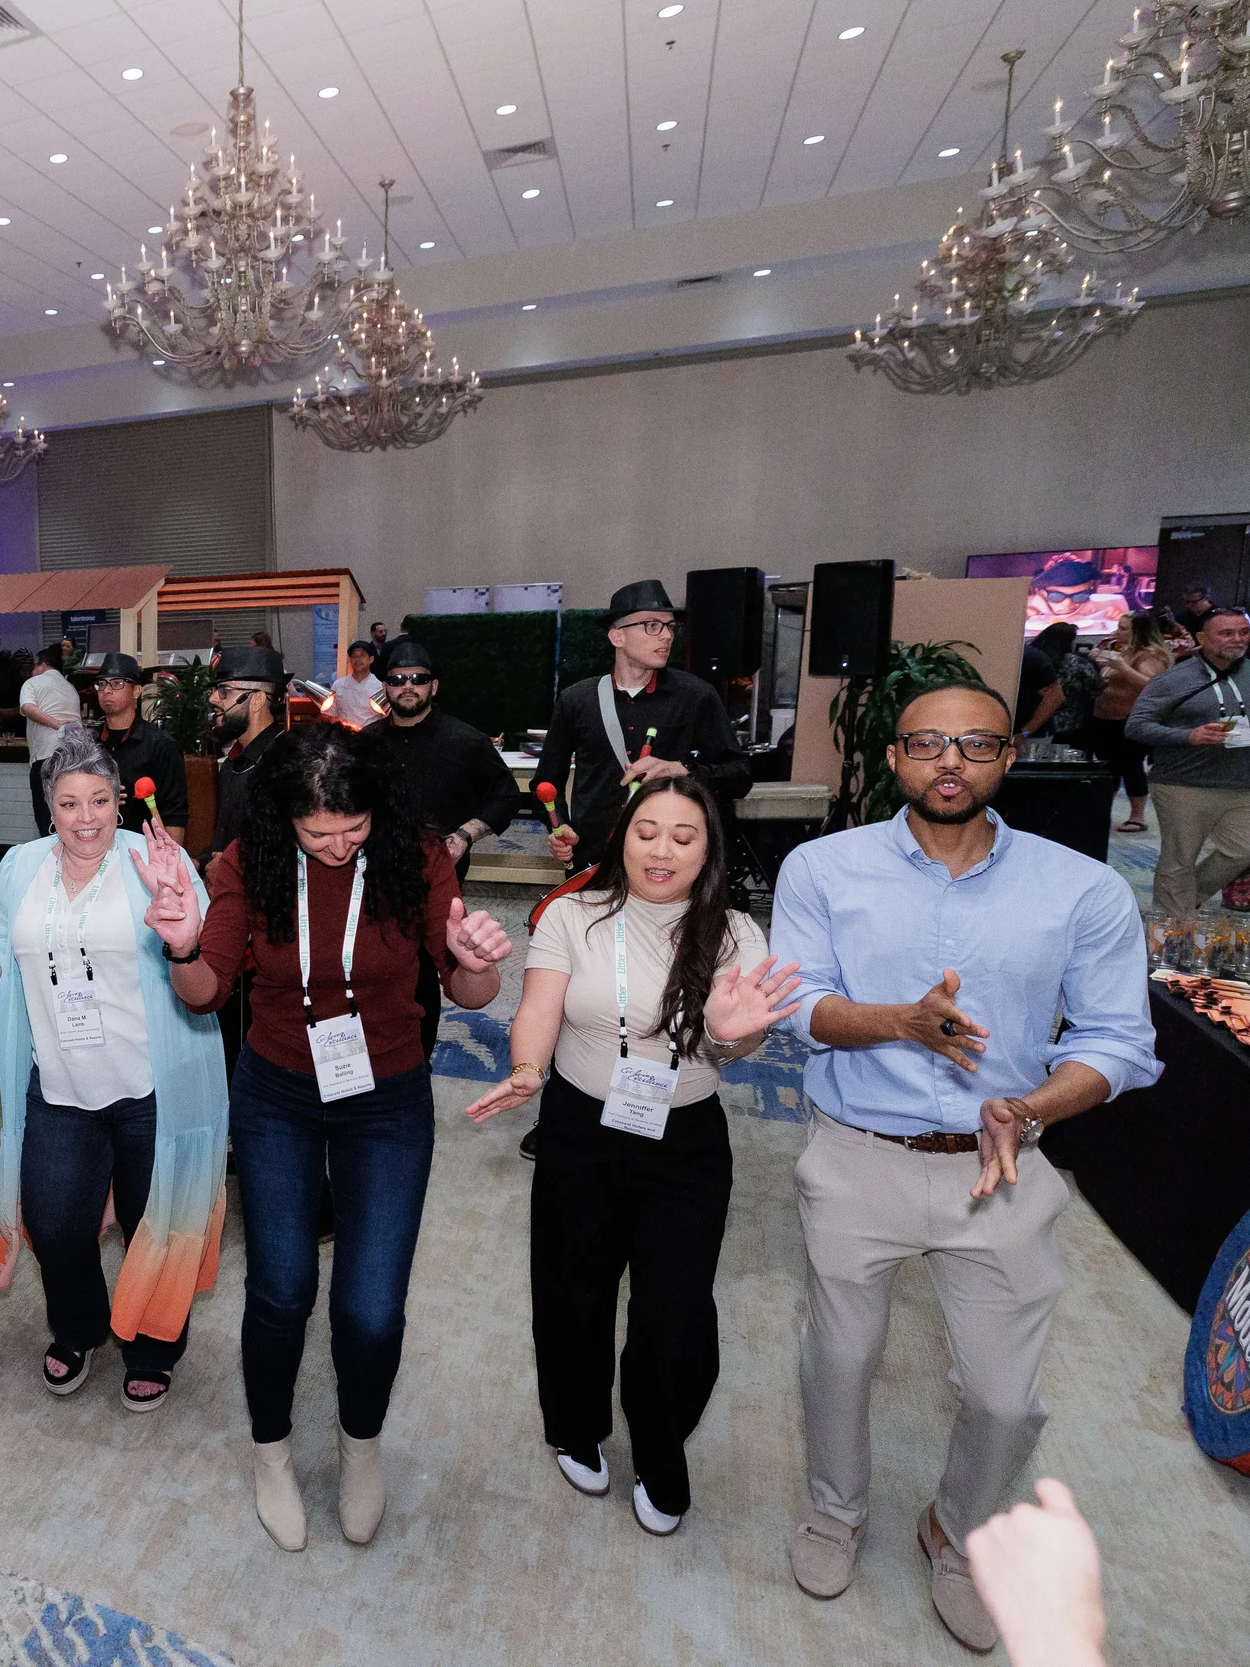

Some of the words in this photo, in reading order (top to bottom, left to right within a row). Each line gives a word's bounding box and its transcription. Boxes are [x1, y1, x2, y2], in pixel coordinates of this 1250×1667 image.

[99, 860, 110, 878] Littler
[53, 870, 62, 889] Littler
[352, 876, 363, 900] Littler
[88, 884, 99, 903] Littler
[48, 897, 56, 916] Littler
[78, 911, 88, 930] Littler
[347, 912, 357, 936] Littler
[616, 922, 624, 943] Littler
[618, 953, 626, 974] Littler
[335, 1070, 354, 1078] Balling
[630, 1109, 644, 1118] Tang
[1225, 1264, 1250, 1361] Mo
